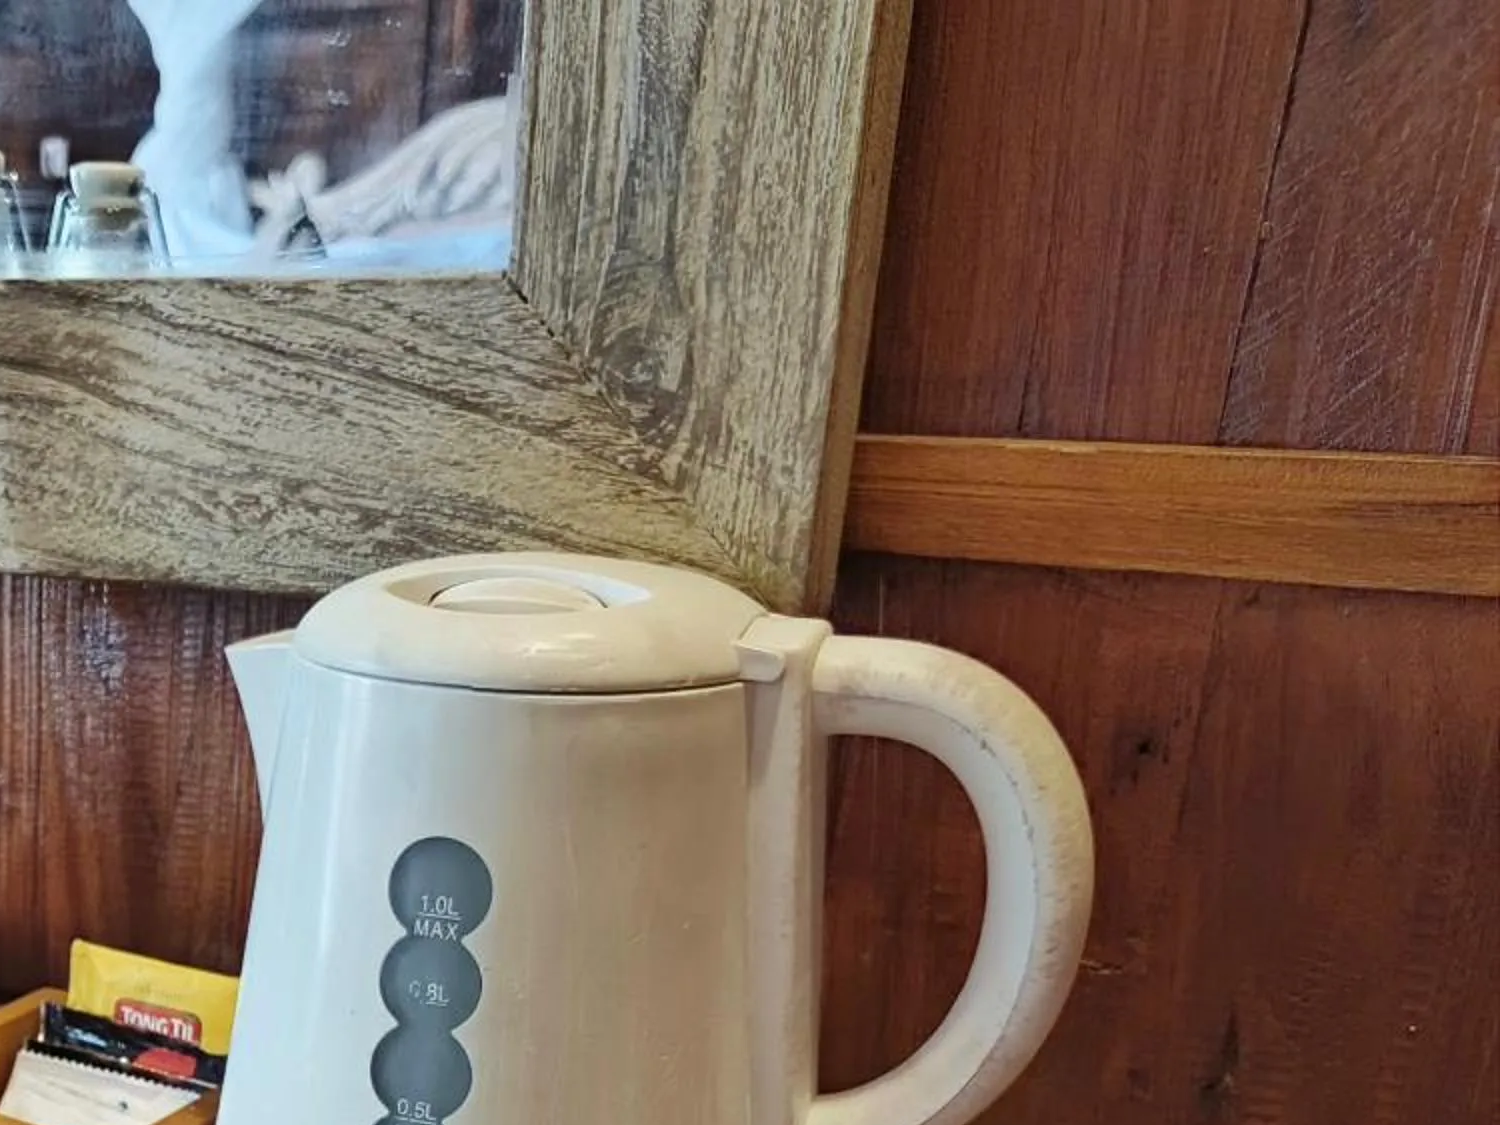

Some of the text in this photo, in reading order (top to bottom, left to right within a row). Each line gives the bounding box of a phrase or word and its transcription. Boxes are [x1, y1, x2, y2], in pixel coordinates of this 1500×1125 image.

[420, 895, 459, 916] 1.0L
[413, 919, 459, 941] MAX
[120, 1005, 169, 1035] TONG
[397, 1098, 436, 1121] 0.5L
